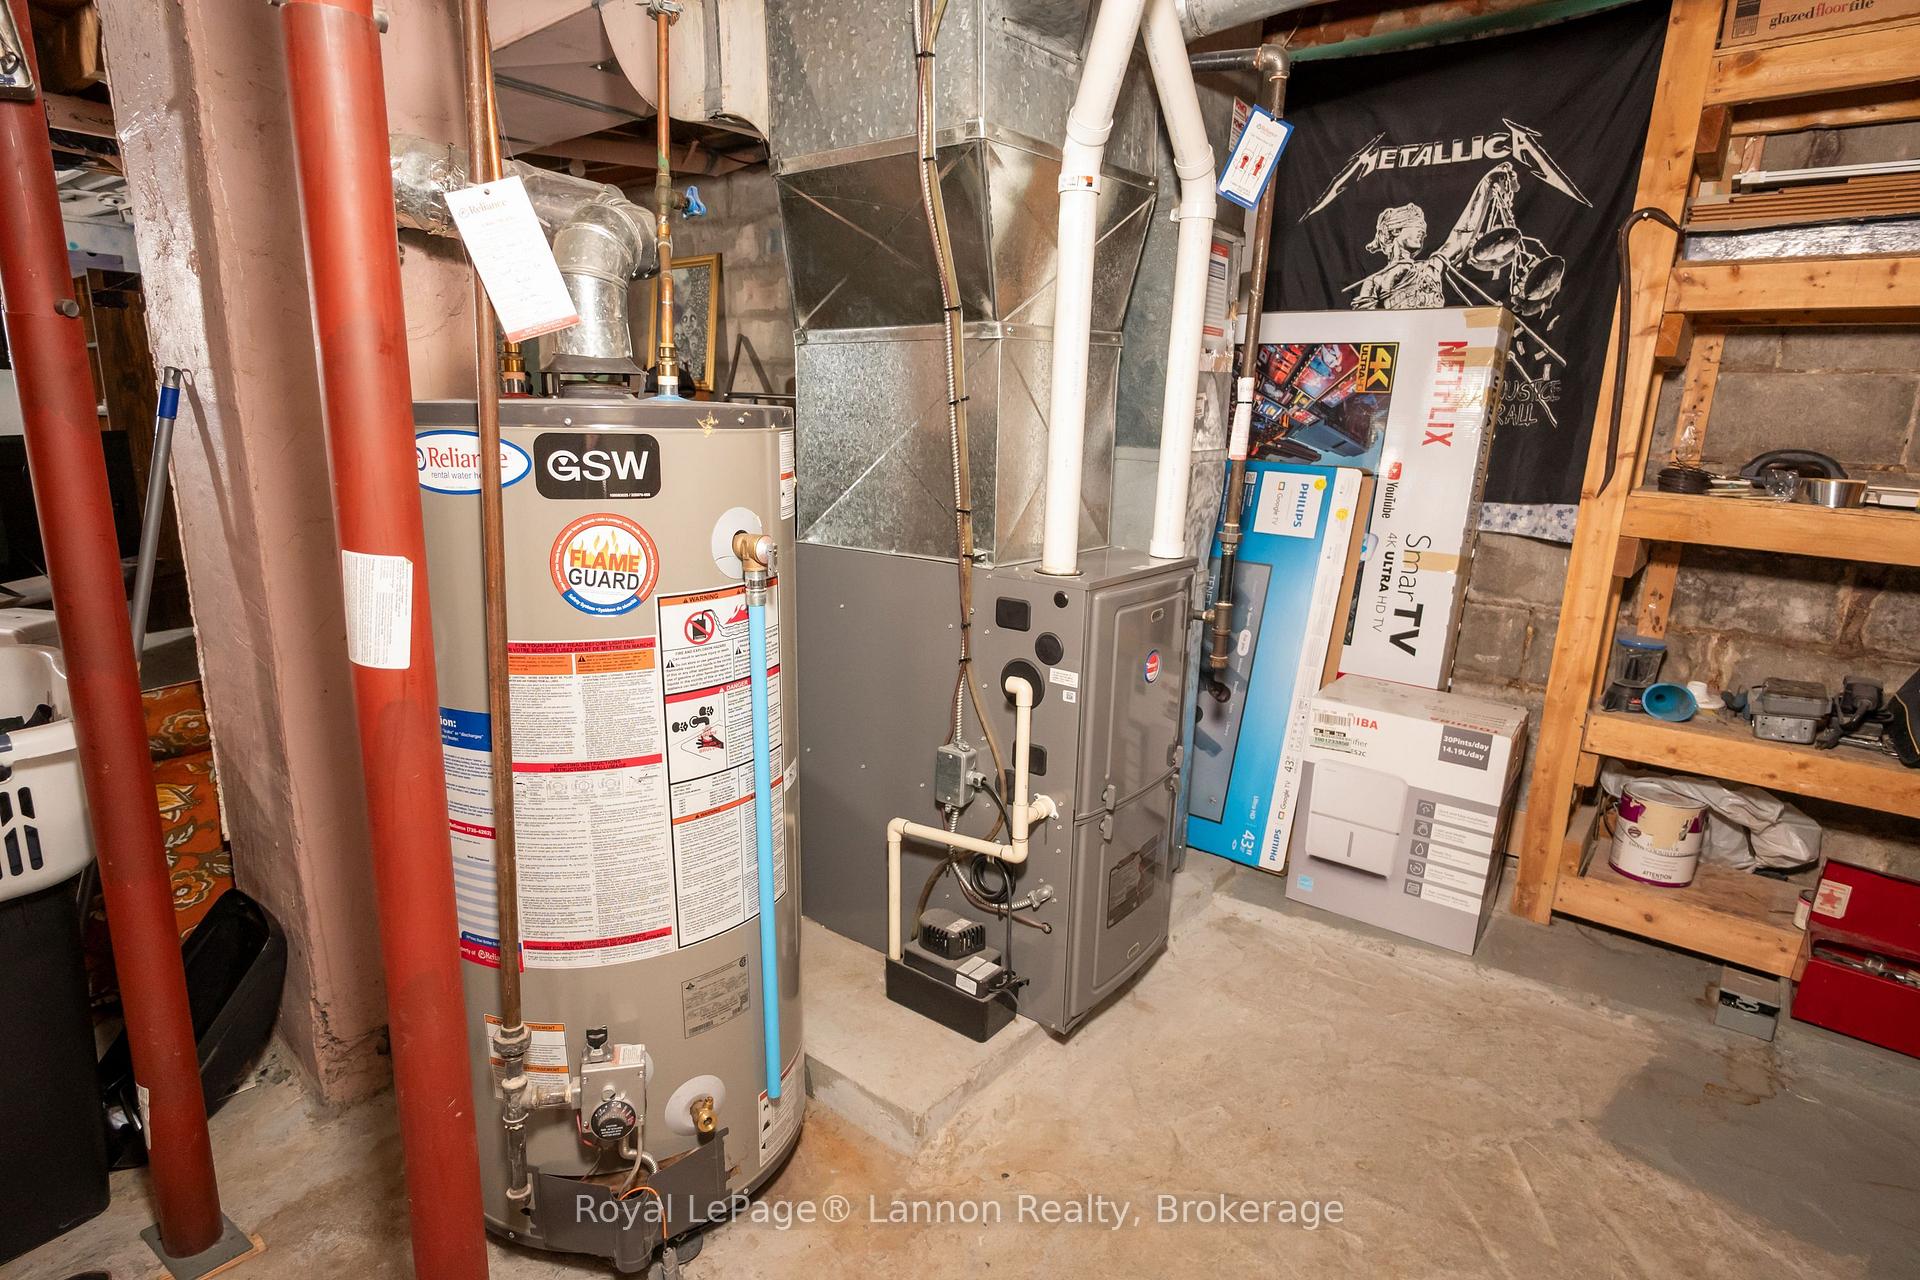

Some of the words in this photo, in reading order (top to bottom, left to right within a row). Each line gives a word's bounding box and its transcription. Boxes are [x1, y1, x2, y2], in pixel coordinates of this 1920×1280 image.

[1298, 118, 1593, 223] METALLICA
[1366, 347, 1392, 388] 4K
[1422, 341, 1468, 447] NETFLIX
[431, 471, 450, 479] rental
[451, 472, 472, 480] water
[546, 450, 649, 481] GSW
[1272, 492, 1284, 517] Google
[1293, 483, 1310, 528] PHILIPS
[1382, 482, 1399, 519] YouTube
[1387, 532, 1398, 548] 4K
[569, 549, 640, 573] FLAME
[1379, 551, 1395, 592] ULTRA
[568, 568, 639, 590] GUARD
[689, 593, 719, 603] WARNING
[1376, 595, 1388, 614] HD
[726, 679, 749, 692] DANGER
[1442, 745, 1485, 761] 14.19L/day
[1443, 735, 1490, 752] 30Pints/day
[1269, 829, 1281, 861] PHILIPS
[1642, 870, 1672, 880] ATTENTION
